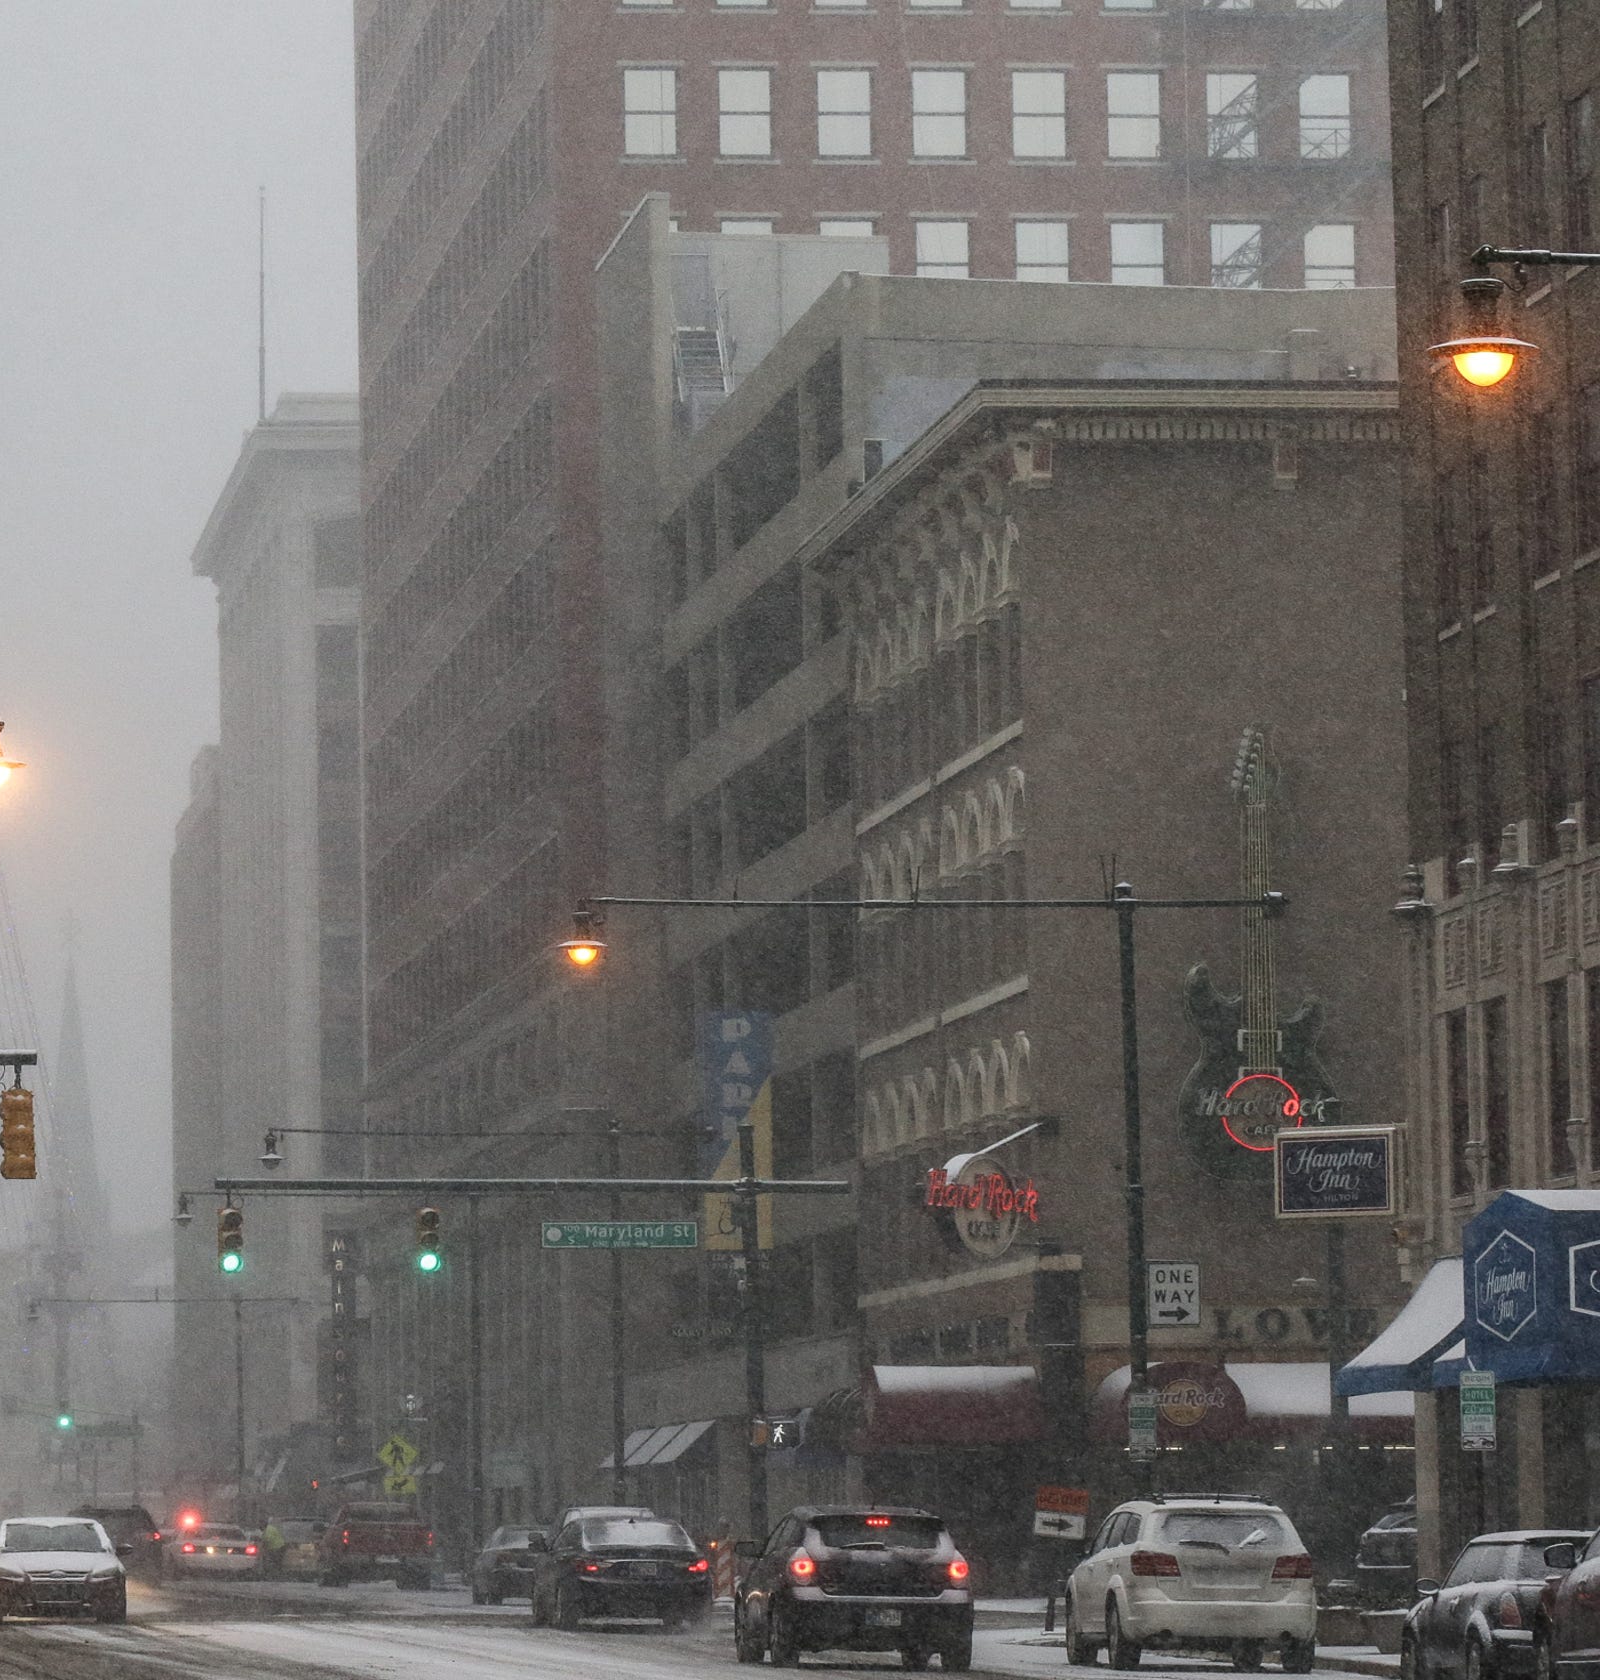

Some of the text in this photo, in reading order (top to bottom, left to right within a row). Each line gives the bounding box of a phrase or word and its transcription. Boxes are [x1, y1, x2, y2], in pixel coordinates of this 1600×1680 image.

[1286, 1146, 1383, 1175] Hampton
[1308, 1168, 1361, 1192] Inn
[927, 1168, 1040, 1223] Hard Rock
[585, 1224, 664, 1240] Maryland
[673, 1225, 689, 1238] St
[1155, 1270, 1194, 1284] ONE
[1480, 1266, 1532, 1304] Hampton
[1154, 1290, 1195, 1303] WAY
[1492, 1293, 1519, 1325] Inn
[1185, 1387, 1225, 1409] Rock
